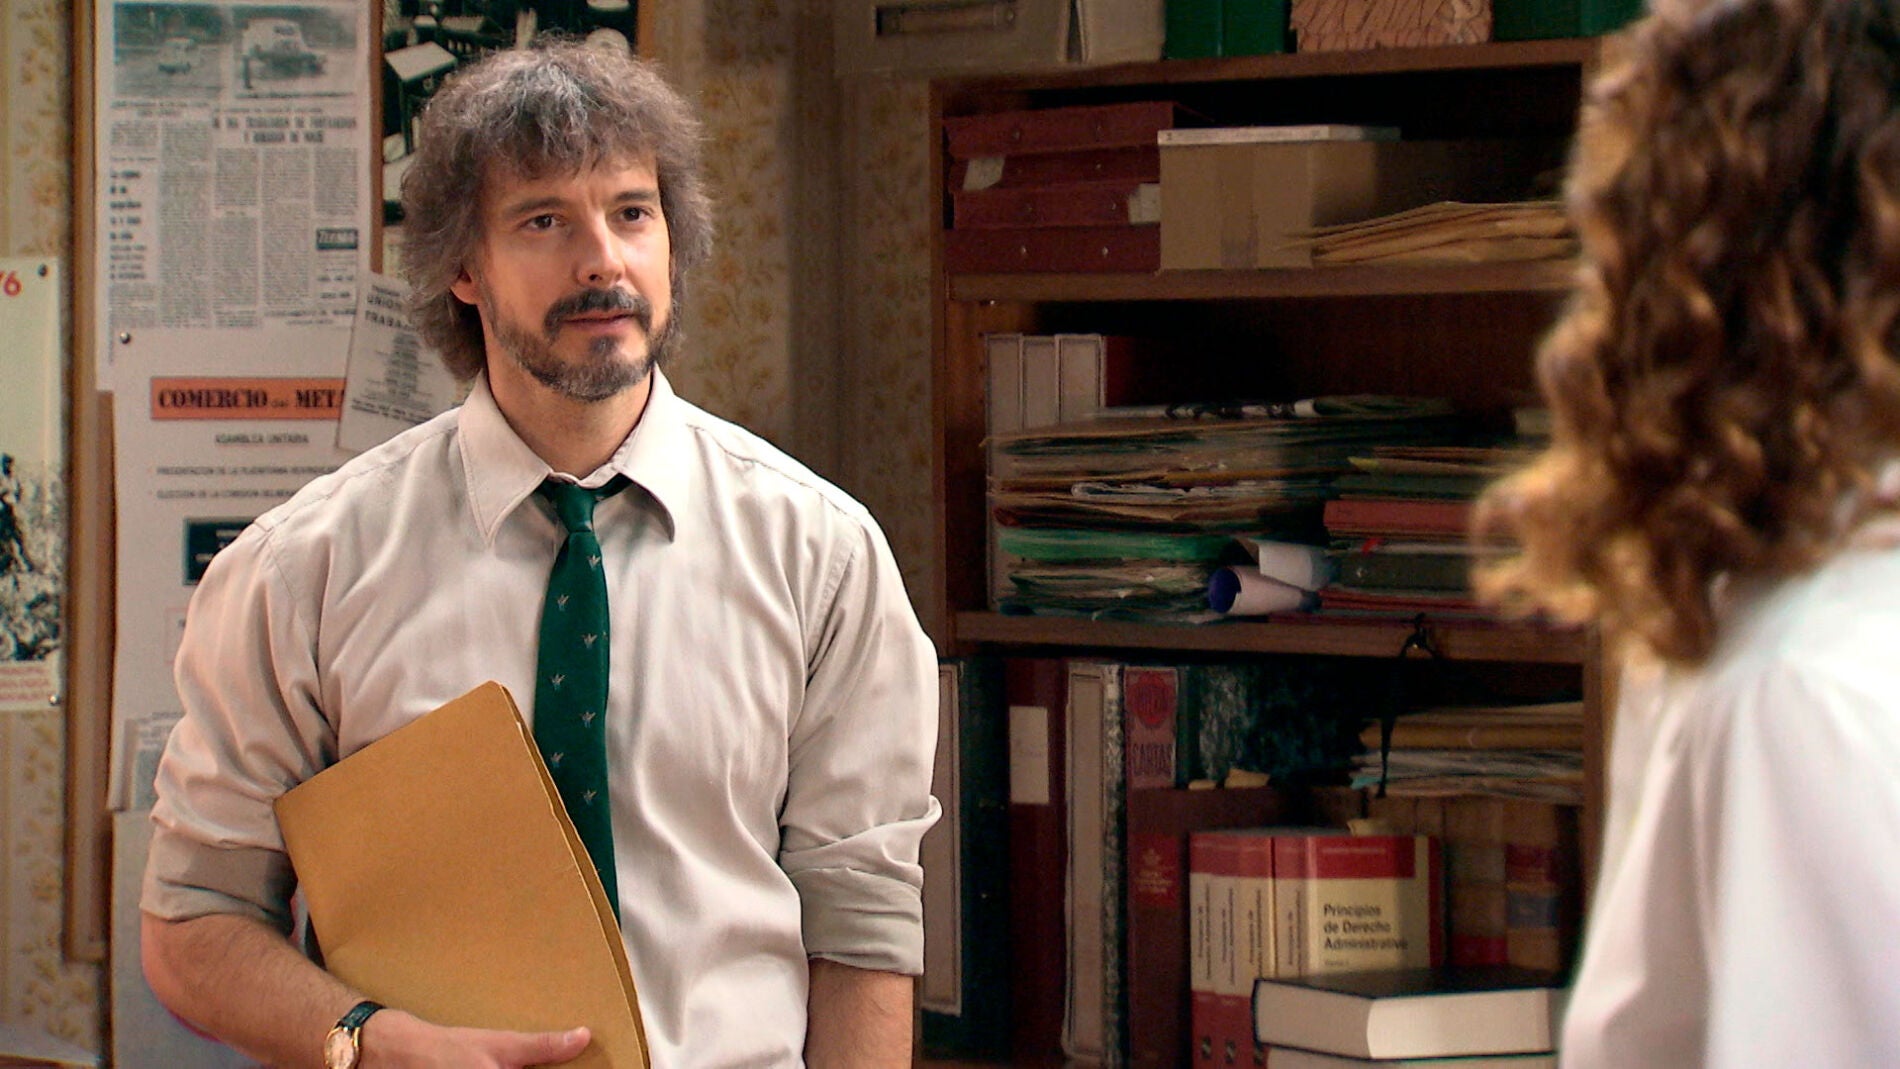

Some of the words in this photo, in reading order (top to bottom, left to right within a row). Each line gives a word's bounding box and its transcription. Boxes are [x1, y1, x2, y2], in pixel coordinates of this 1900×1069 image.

[158, 388, 268, 408] COMERCIO
[1323, 903, 1382, 919] Principios
[1323, 920, 1339, 934] de
[1342, 920, 1391, 934] Derecho
[1323, 936, 1409, 951] Administrativo
